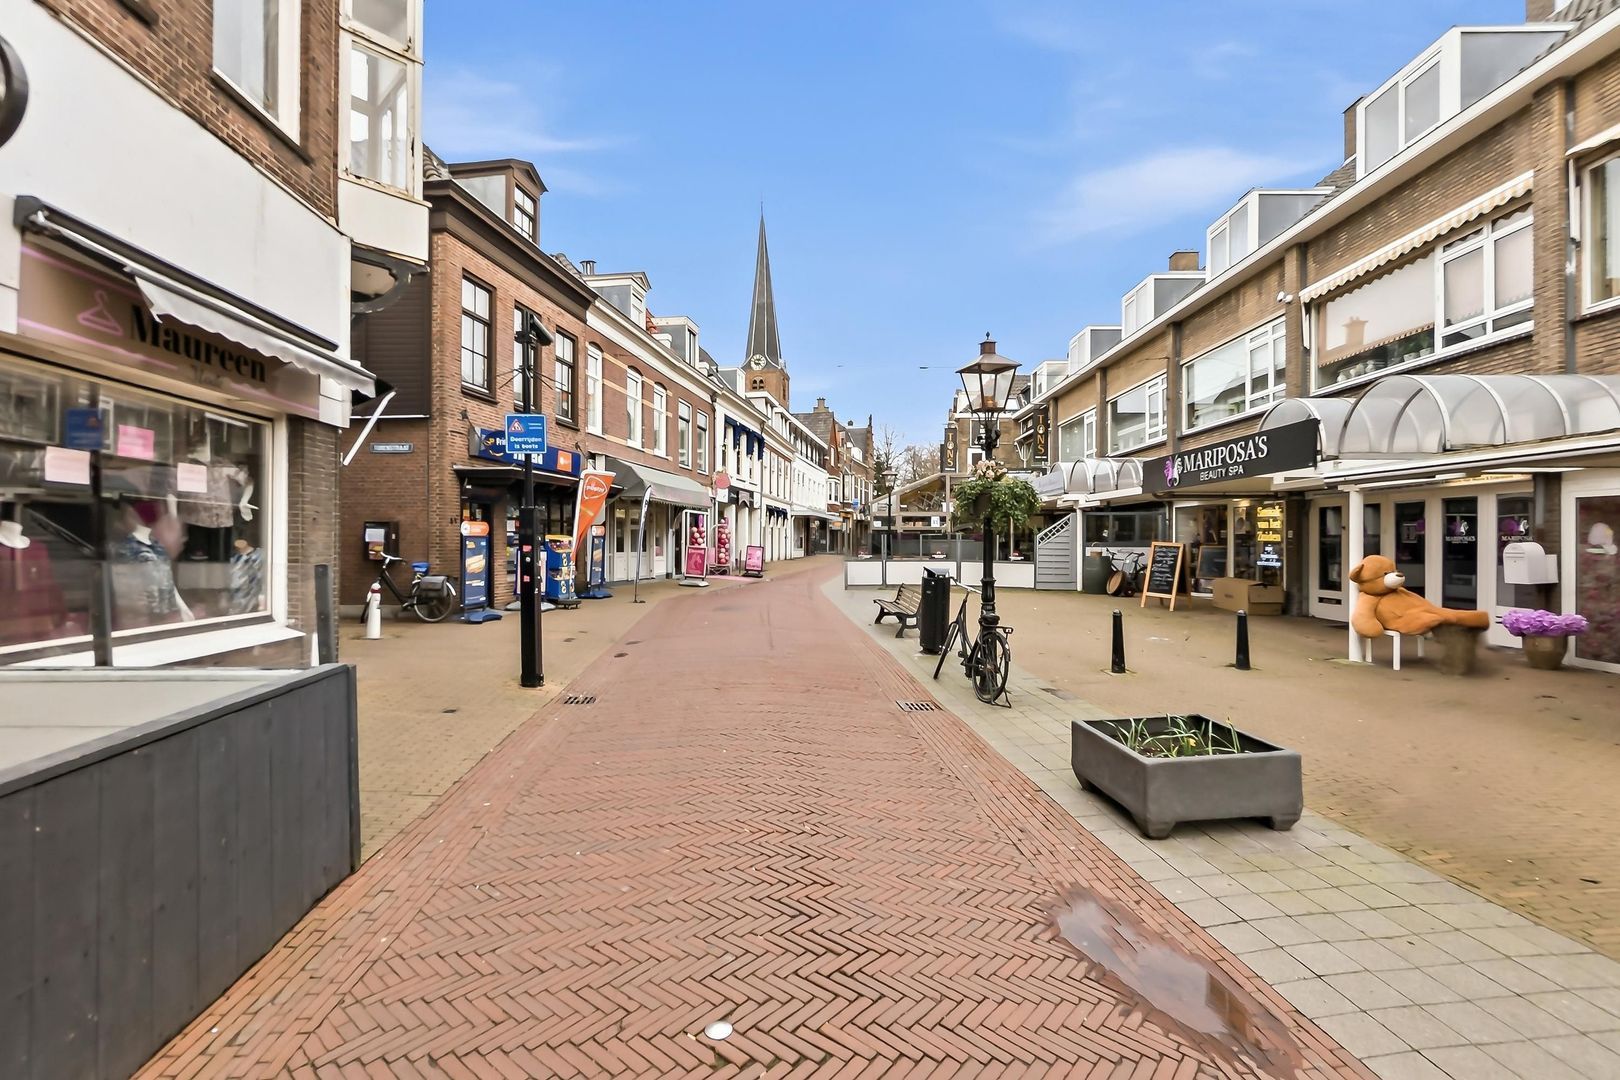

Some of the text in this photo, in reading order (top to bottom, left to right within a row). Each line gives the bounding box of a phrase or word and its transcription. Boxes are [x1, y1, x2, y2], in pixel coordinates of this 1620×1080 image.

[131, 304, 266, 382] Maureen
[1184, 436, 1268, 472] MARIPOSA'S
[1200, 465, 1244, 481] BEAUTY SPA
